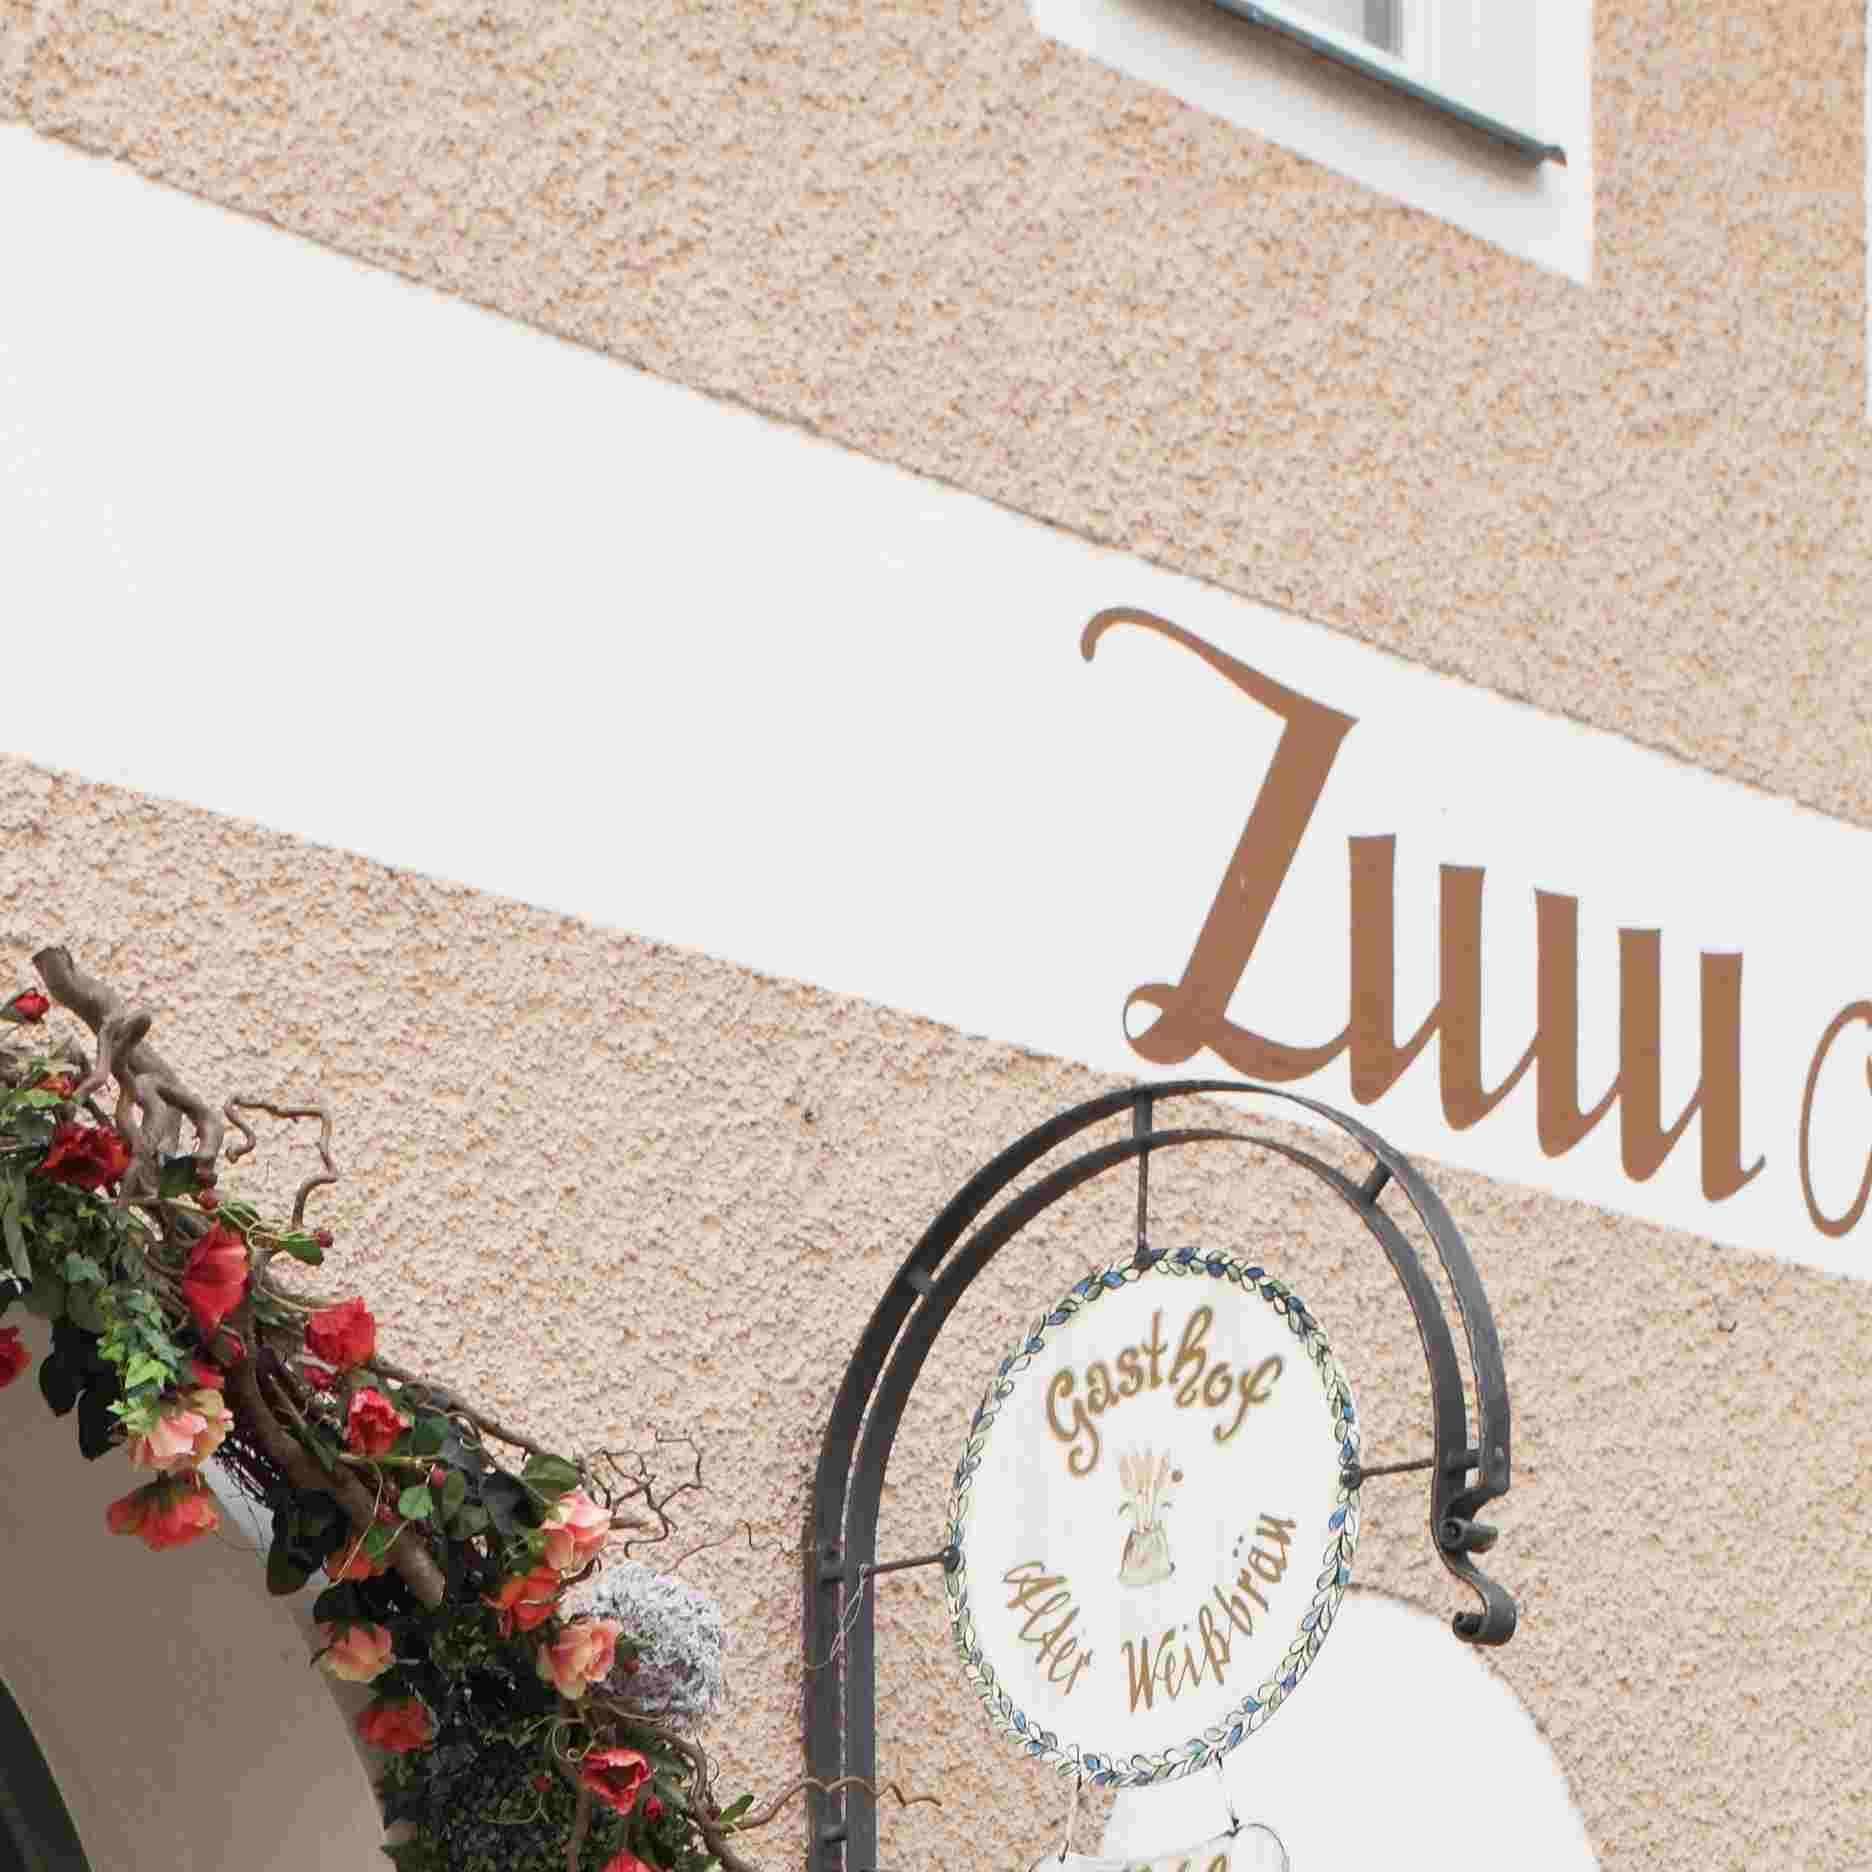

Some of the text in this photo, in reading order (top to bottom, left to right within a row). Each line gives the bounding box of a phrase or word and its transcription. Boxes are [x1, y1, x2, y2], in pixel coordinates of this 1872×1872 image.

[1081, 606, 1767, 1202] Zum
[1043, 1304, 1284, 1477] Gasthof
[1003, 1559, 1098, 1697] Alter
[1120, 1511, 1297, 1714] Weißbräu
